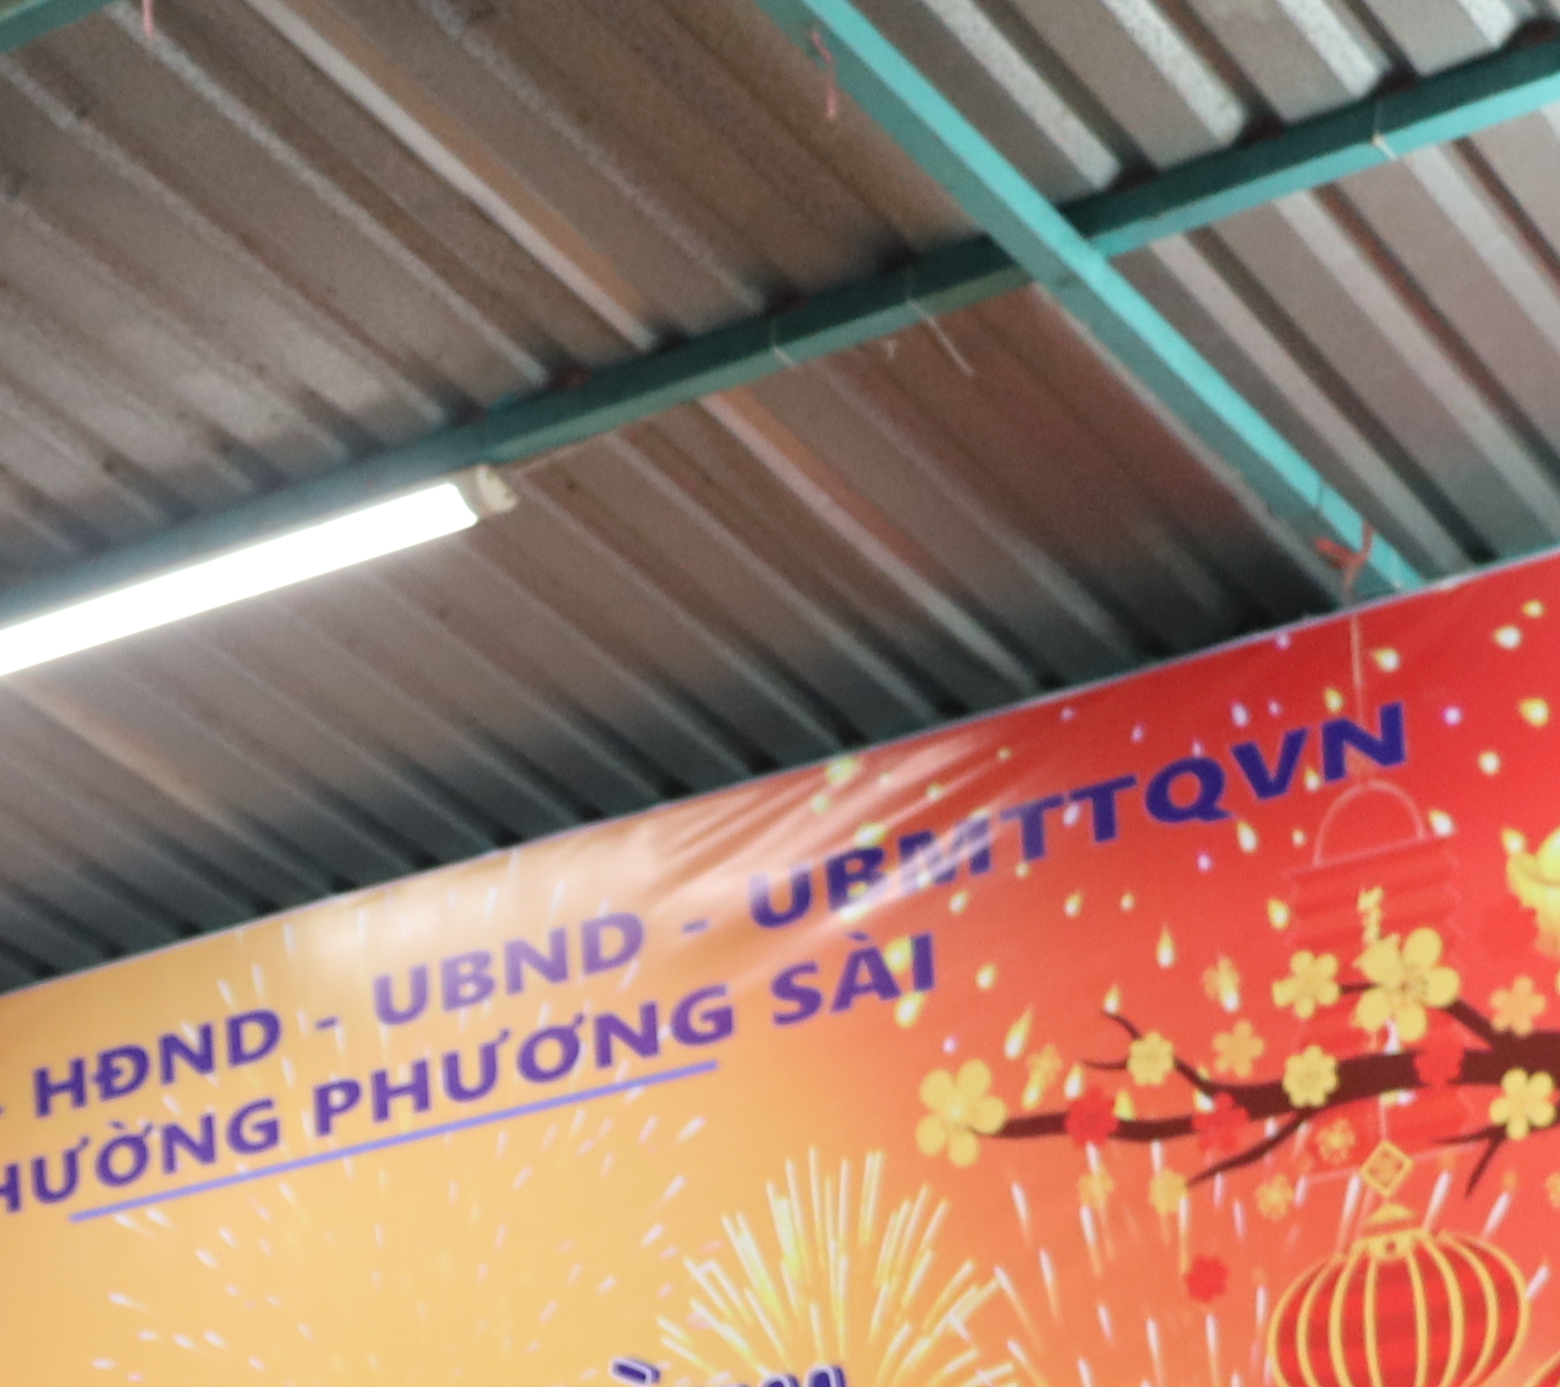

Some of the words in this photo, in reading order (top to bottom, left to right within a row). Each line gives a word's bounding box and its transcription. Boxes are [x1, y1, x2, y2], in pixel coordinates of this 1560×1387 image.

[32, 1008, 282, 1117] HĐND
[371, 911, 646, 1028] UBND
[747, 702, 1407, 930] UBMTTQVN
[312, 983, 735, 1137] PHƯƠNG
[769, 930, 936, 1026] SÀI
